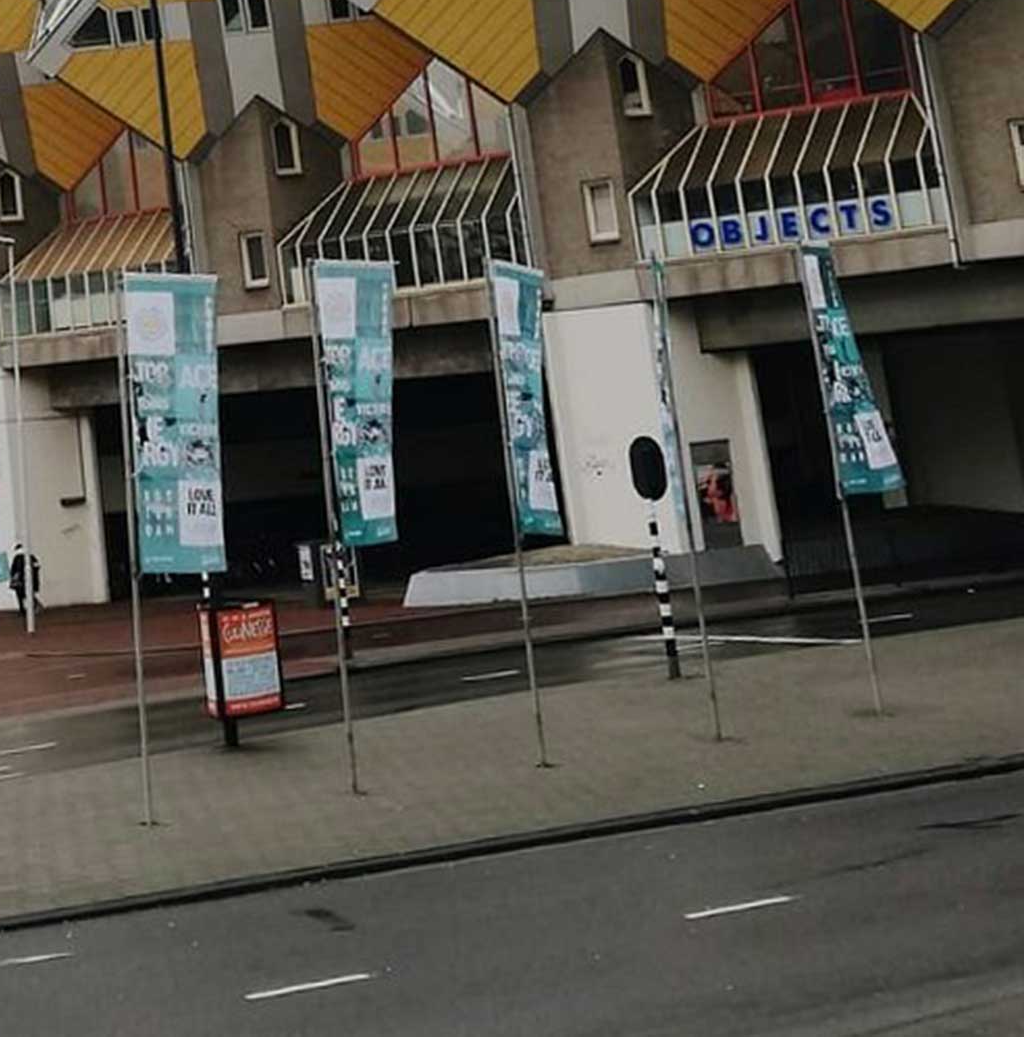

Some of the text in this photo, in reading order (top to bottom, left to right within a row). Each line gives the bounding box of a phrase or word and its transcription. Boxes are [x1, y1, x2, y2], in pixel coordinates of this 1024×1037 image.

[690, 199, 891, 247] OBJECTS
[188, 488, 215, 502] LOVE
[187, 503, 198, 516] IT
[199, 503, 217, 516] ALL
